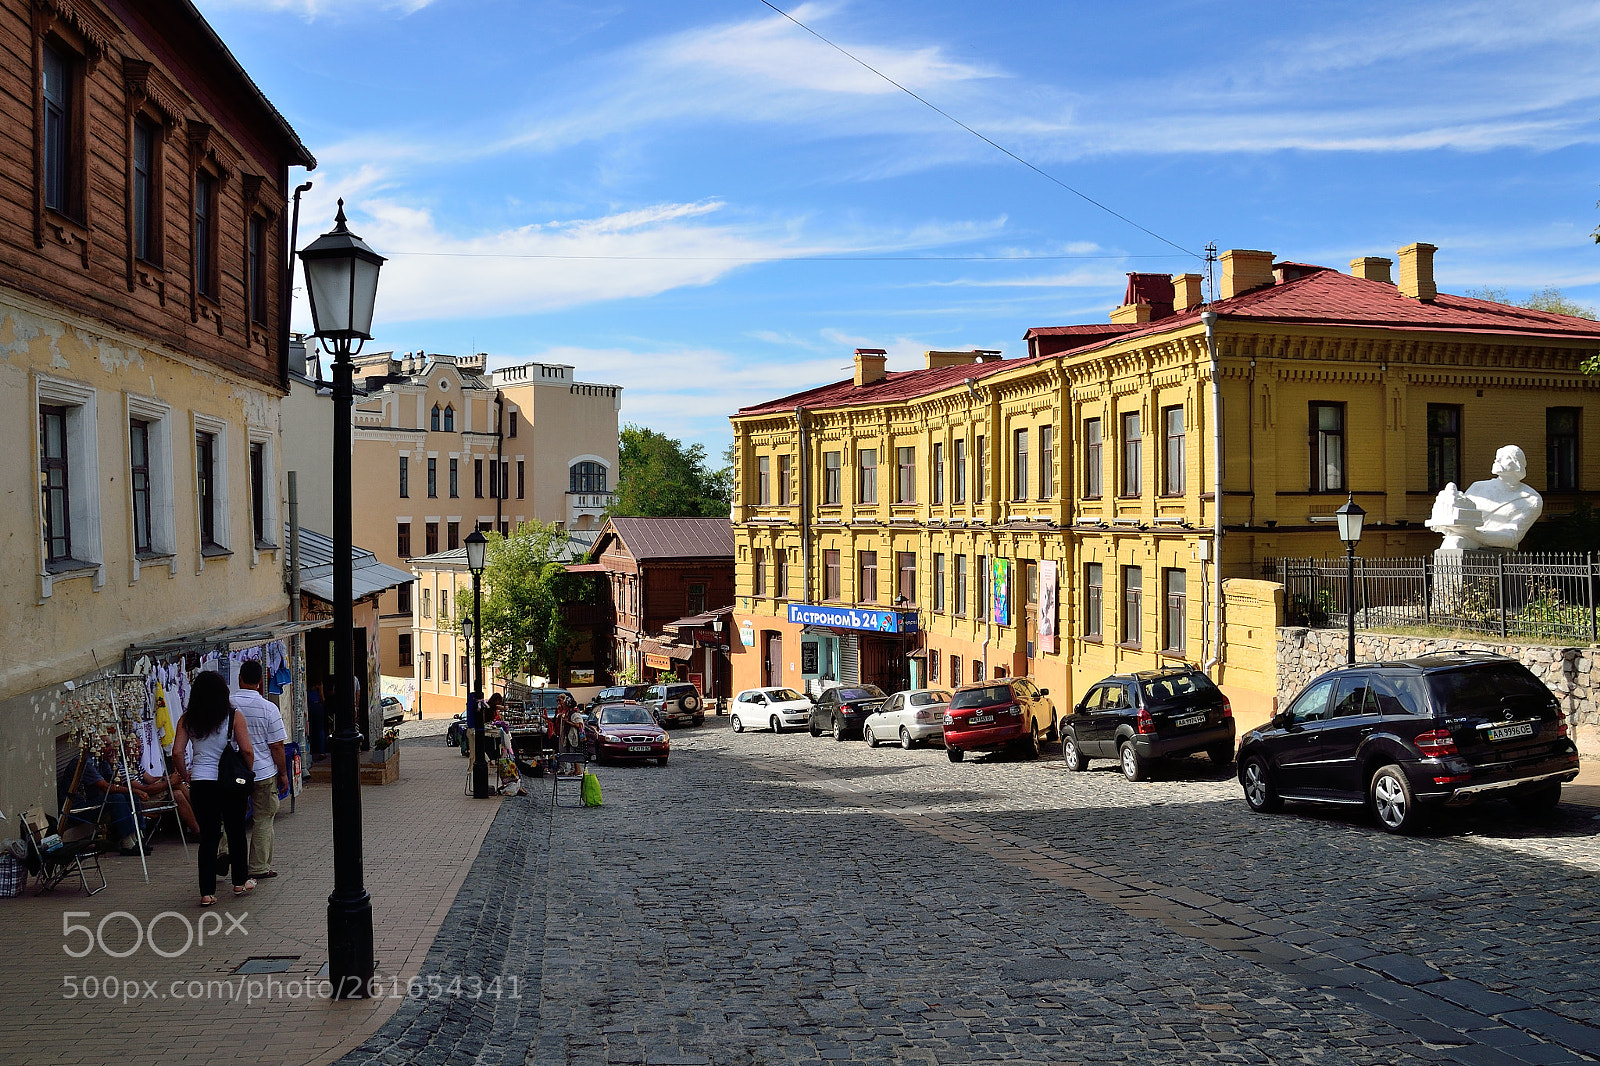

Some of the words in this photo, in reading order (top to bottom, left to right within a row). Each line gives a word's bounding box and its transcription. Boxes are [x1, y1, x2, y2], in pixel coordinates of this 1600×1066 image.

[863, 613, 877, 628] 24
[1493, 730, 1503, 739] AA
[1504, 727, 1520, 737] 9996
[1520, 724, 1531, 734] OE
